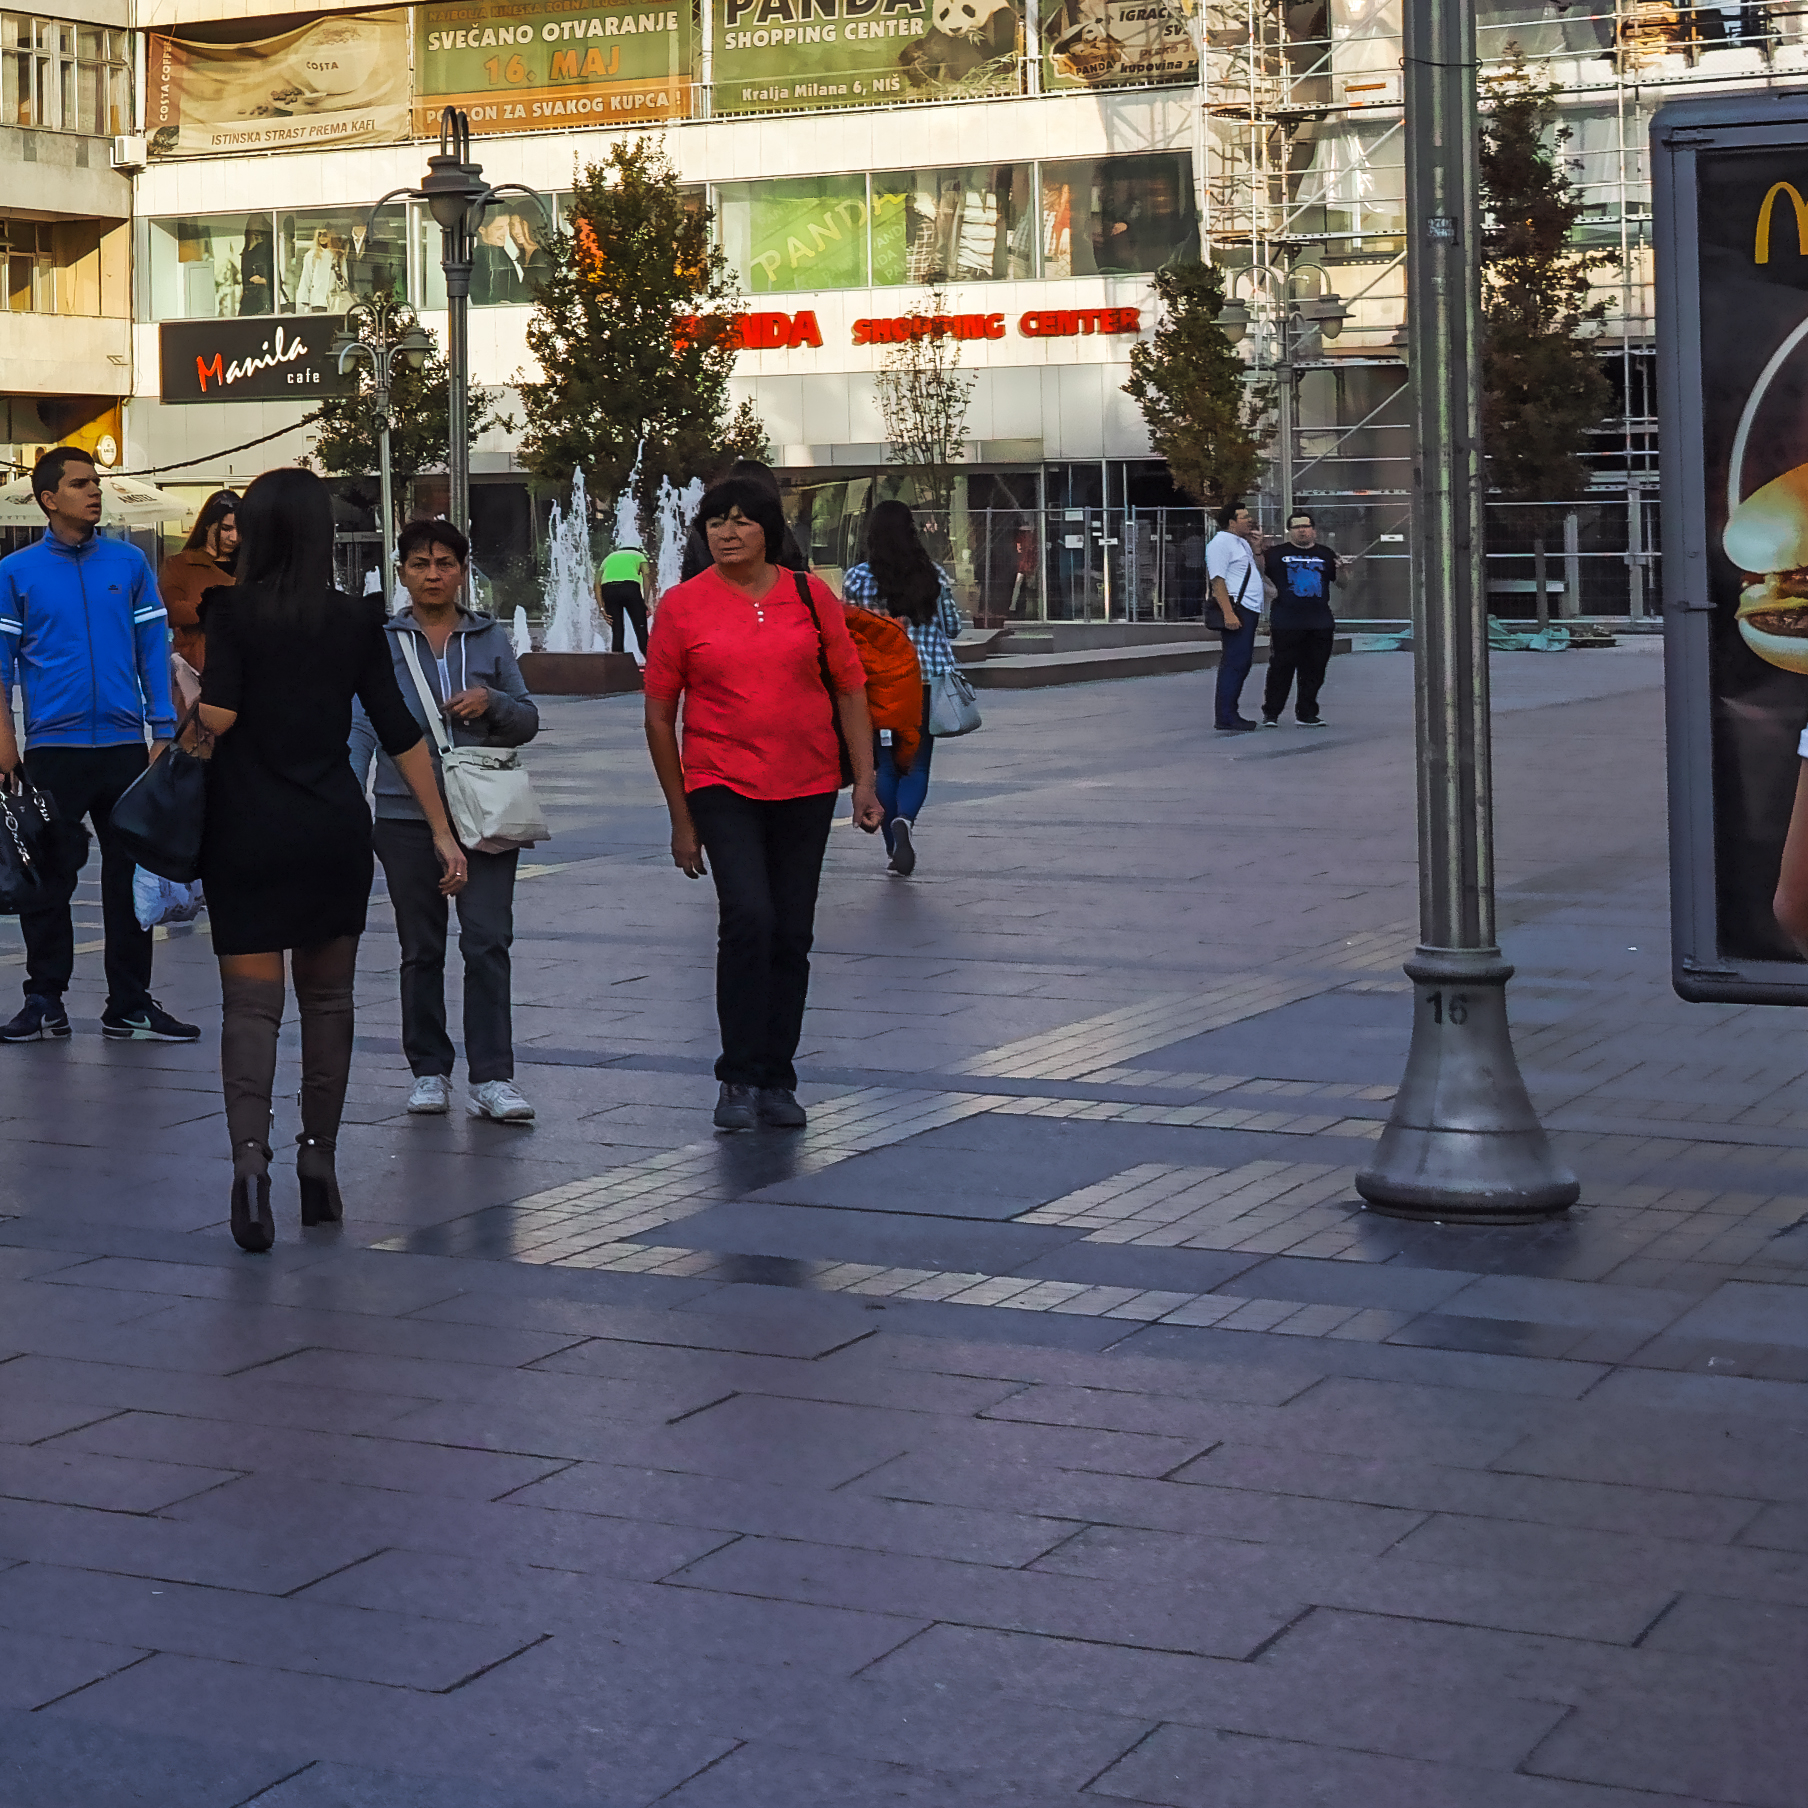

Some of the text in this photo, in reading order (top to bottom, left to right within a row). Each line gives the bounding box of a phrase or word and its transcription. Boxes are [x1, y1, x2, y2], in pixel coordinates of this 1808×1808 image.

[428, 11, 679, 51] SVEČANO OTVARANJE
[725, 18, 924, 50] SHOPPING CENTER
[1164, 24, 1189, 37] SV
[306, 61, 339, 72] COSTA
[484, 45, 620, 85] 16. MAJ
[1076, 59, 1114, 76] PANDA
[1120, 59, 1183, 74] kupovina
[742, 73, 900, 102] Kralja Milana 6, NIŠ
[159, 84, 170, 122] COSTA
[503, 103, 526, 119] ZA
[533, 97, 604, 118] SVAKOG
[610, 91, 670, 111] KUPCA
[211, 119, 375, 146] ISTINSKA STRAST PREMA KAFI
[1018, 307, 1141, 338] CENTER
[196, 325, 308, 393] Manila
[287, 368, 320, 384] cafe
[1426, 991, 1468, 1025] 16
